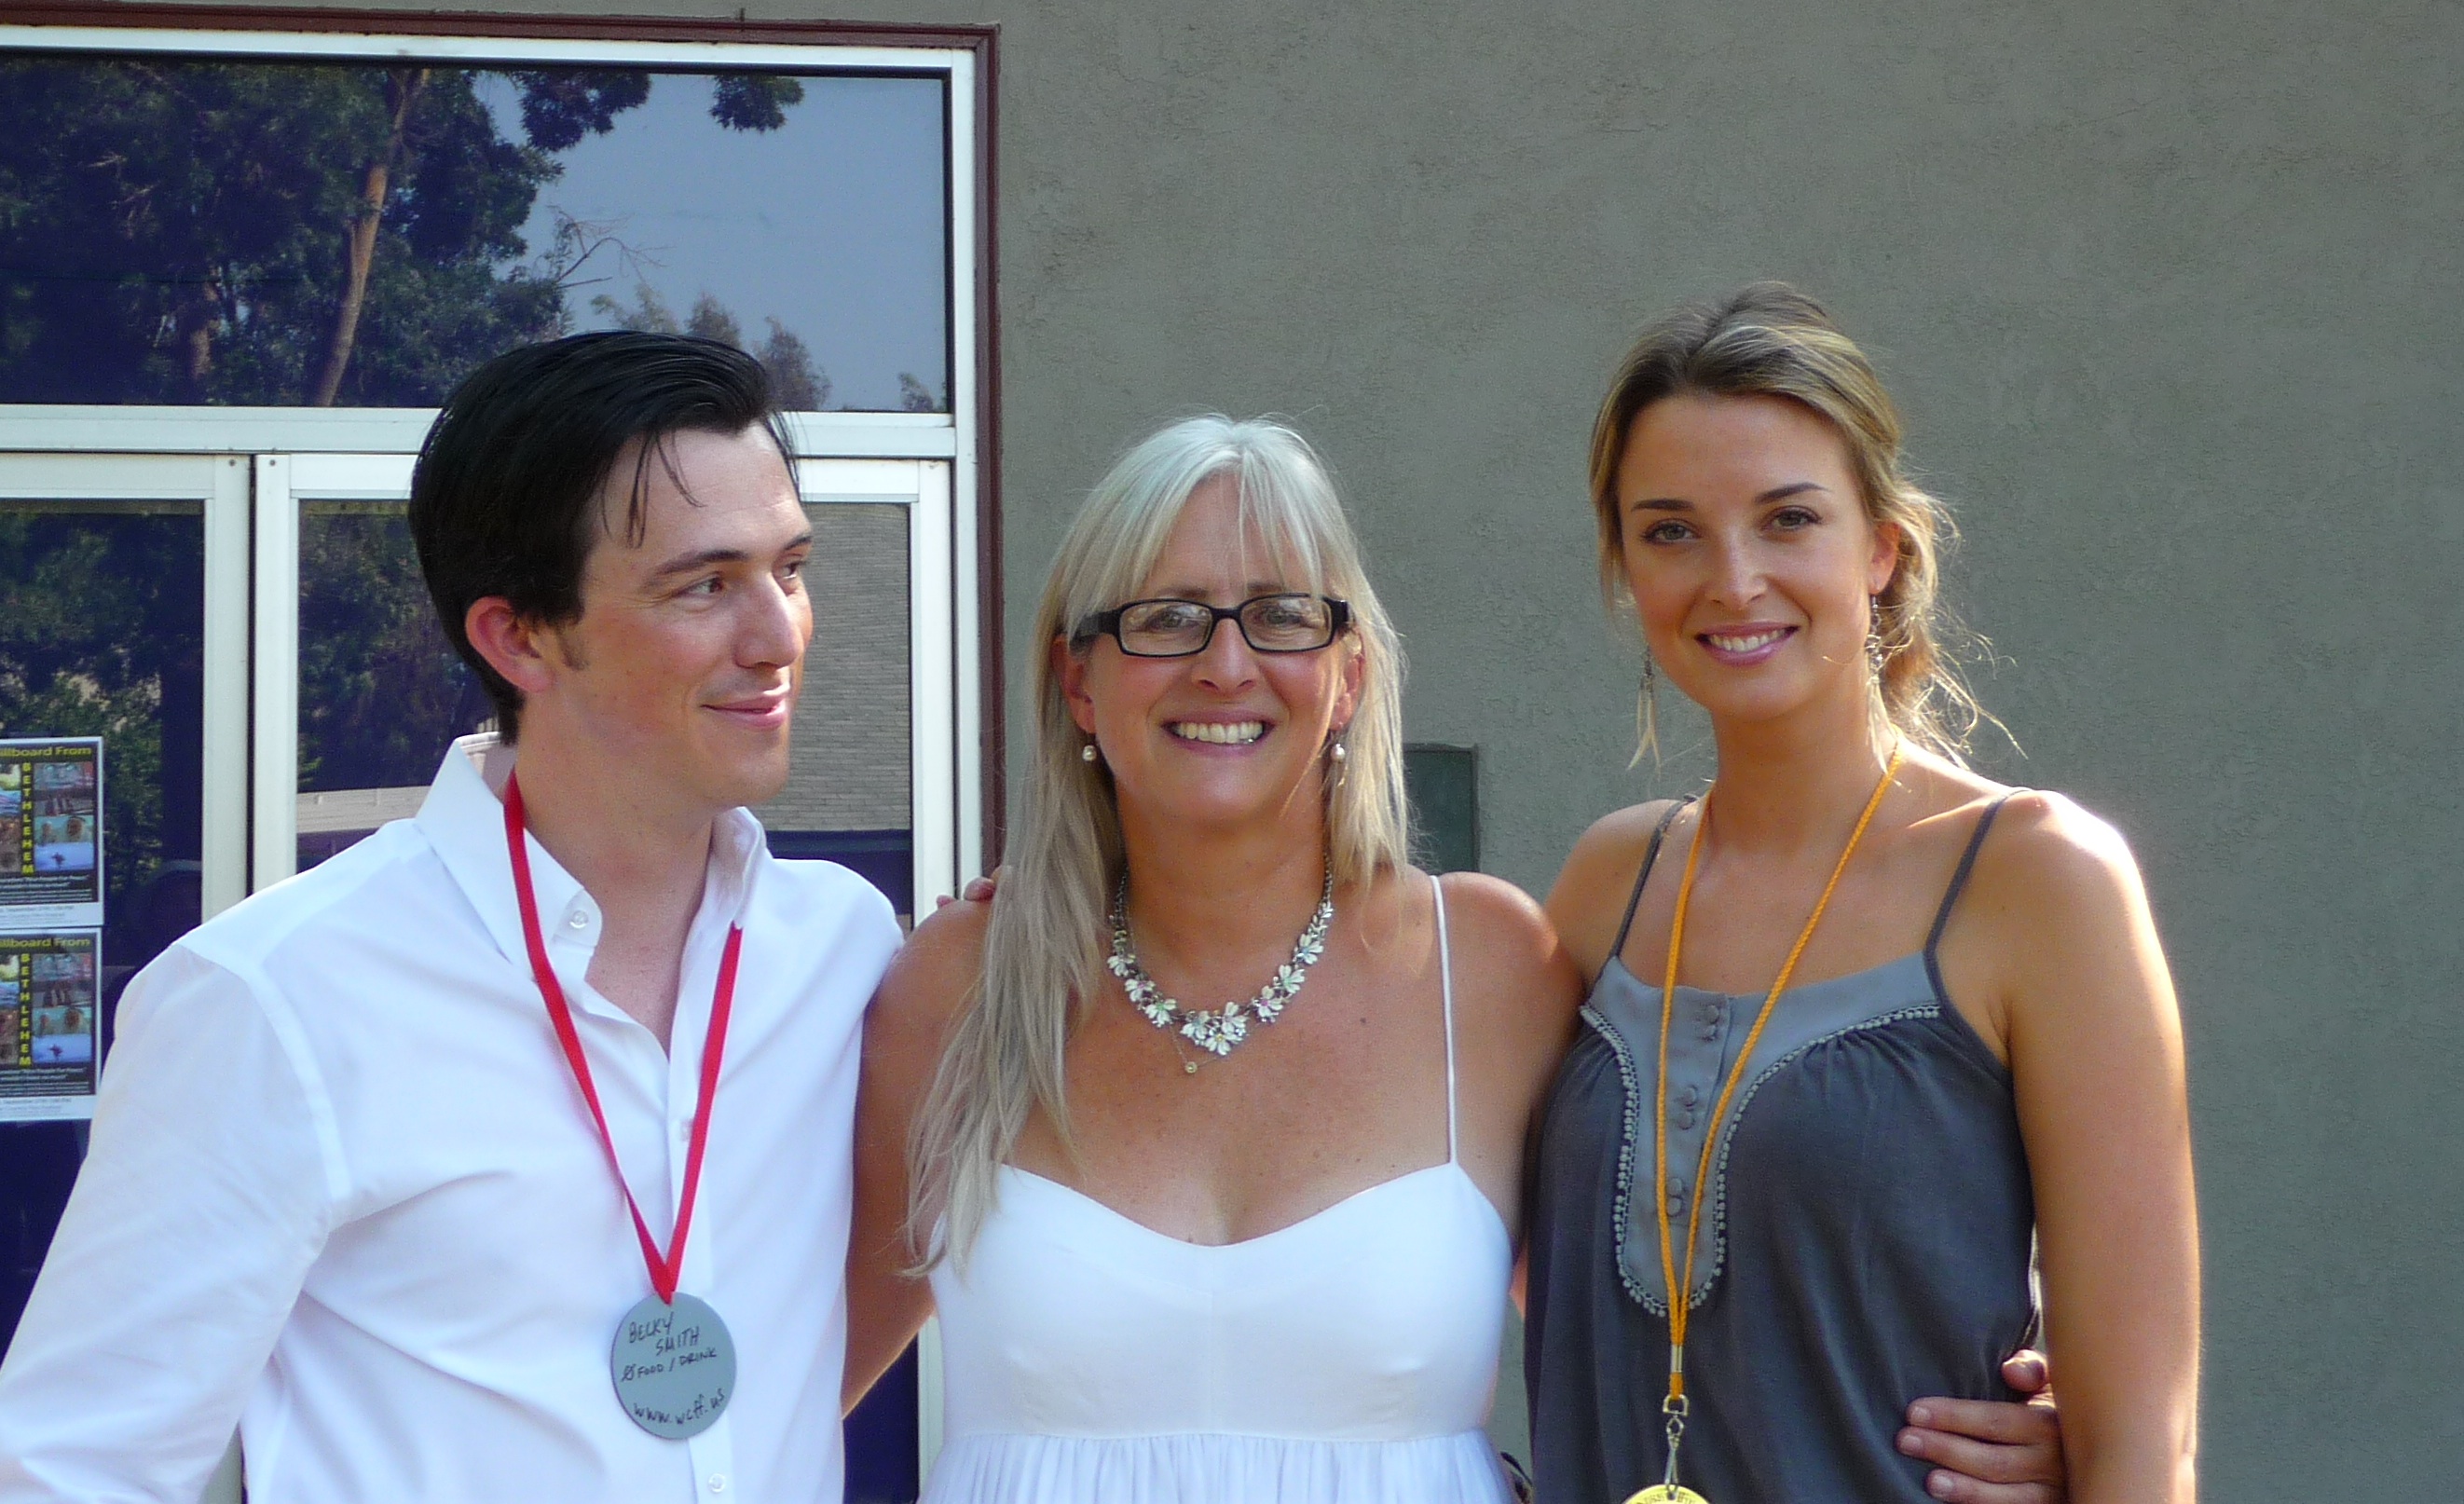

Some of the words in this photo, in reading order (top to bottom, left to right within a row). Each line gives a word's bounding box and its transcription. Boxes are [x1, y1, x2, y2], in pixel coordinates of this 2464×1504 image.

[56, 746, 91, 755] From
[22, 762, 34, 875] BETHLEHEM
[20, 953, 31, 1066] BETHLEHEM
[629, 1311, 674, 1344] BECKY
[656, 1326, 700, 1356] SMITH
